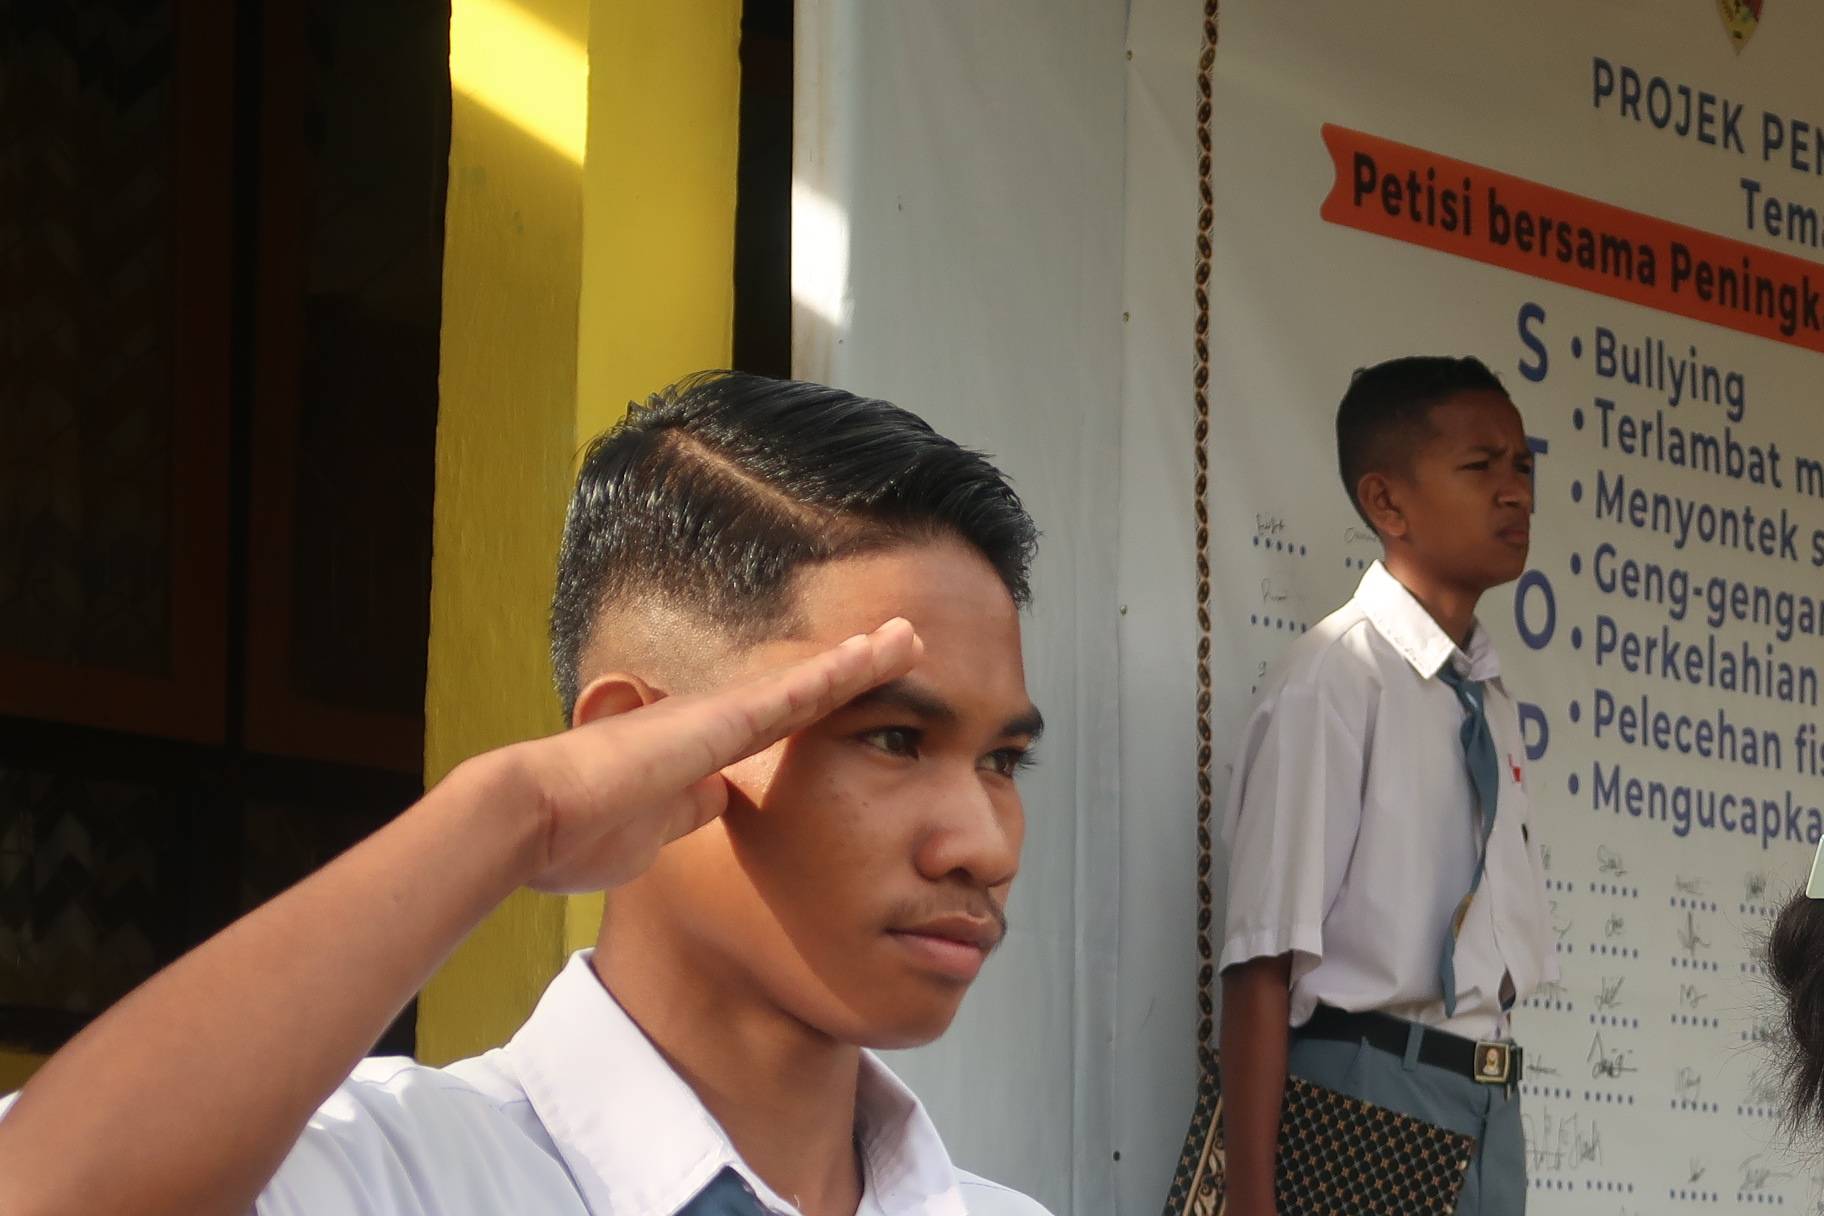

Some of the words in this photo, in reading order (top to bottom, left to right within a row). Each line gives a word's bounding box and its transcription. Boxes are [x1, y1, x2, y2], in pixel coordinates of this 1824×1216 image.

[1593, 56, 1744, 155] PROJEK
[1353, 151, 1472, 236] Petisi
[1488, 186, 1656, 288] bersama
[1595, 326, 1745, 423] Bullying
[1595, 397, 1782, 488] Terlambat
[1596, 470, 1798, 561] Menyontek
[1596, 615, 1818, 705] Perkelahian
[1594, 688, 1777, 769] Pelecehan
